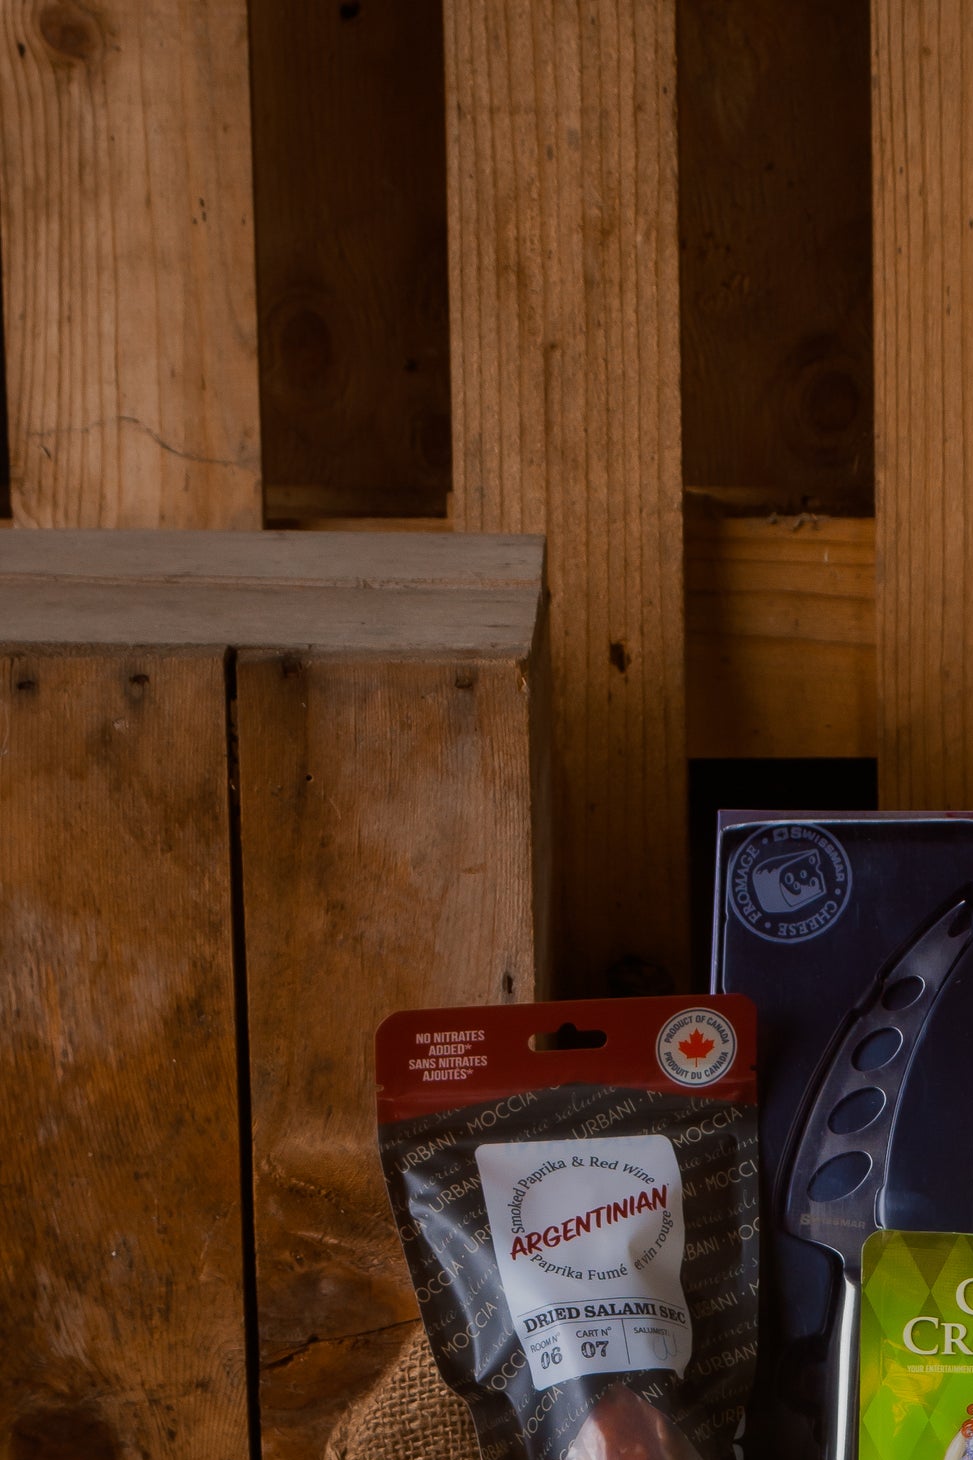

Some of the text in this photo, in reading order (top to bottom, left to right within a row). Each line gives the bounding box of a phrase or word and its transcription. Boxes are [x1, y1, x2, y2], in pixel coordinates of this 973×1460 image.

[789, 826, 845, 882] SWISSMAR
[735, 844, 762, 924] FROMAGE
[777, 900, 838, 936] CHEESE
[416, 1030, 486, 1044] NO NITRATES
[664, 1015, 730, 1044] PRODUCT OF CANADA
[408, 1056, 488, 1070] SANS NITRATES
[664, 1052, 689, 1078] PRODUIT
[704, 1052, 729, 1077] CANADA
[397, 1131, 457, 1174] URBANI
[466, 1090, 538, 1135] MOCCIA
[572, 1098, 637, 1140] URBANI
[673, 1106, 744, 1148] MOCCIA
[508, 1156, 656, 1234] Smoked Paprika & Red Wine
[510, 1184, 668, 1260] ARGENTINIAN
[530, 1210, 674, 1281] Paprika Fumé vin rouge
[440, 1301, 498, 1358] MOCCIA
[523, 1303, 687, 1333] DRIED SALAMI SEC
[576, 1329, 599, 1338] CART
[530, 1340, 551, 1353] ROOM
[541, 1346, 563, 1370] 06
[580, 1340, 609, 1358] 07
[907, 1364, 924, 1374] YOUR
[515, 1386, 564, 1447] MOCCIA
